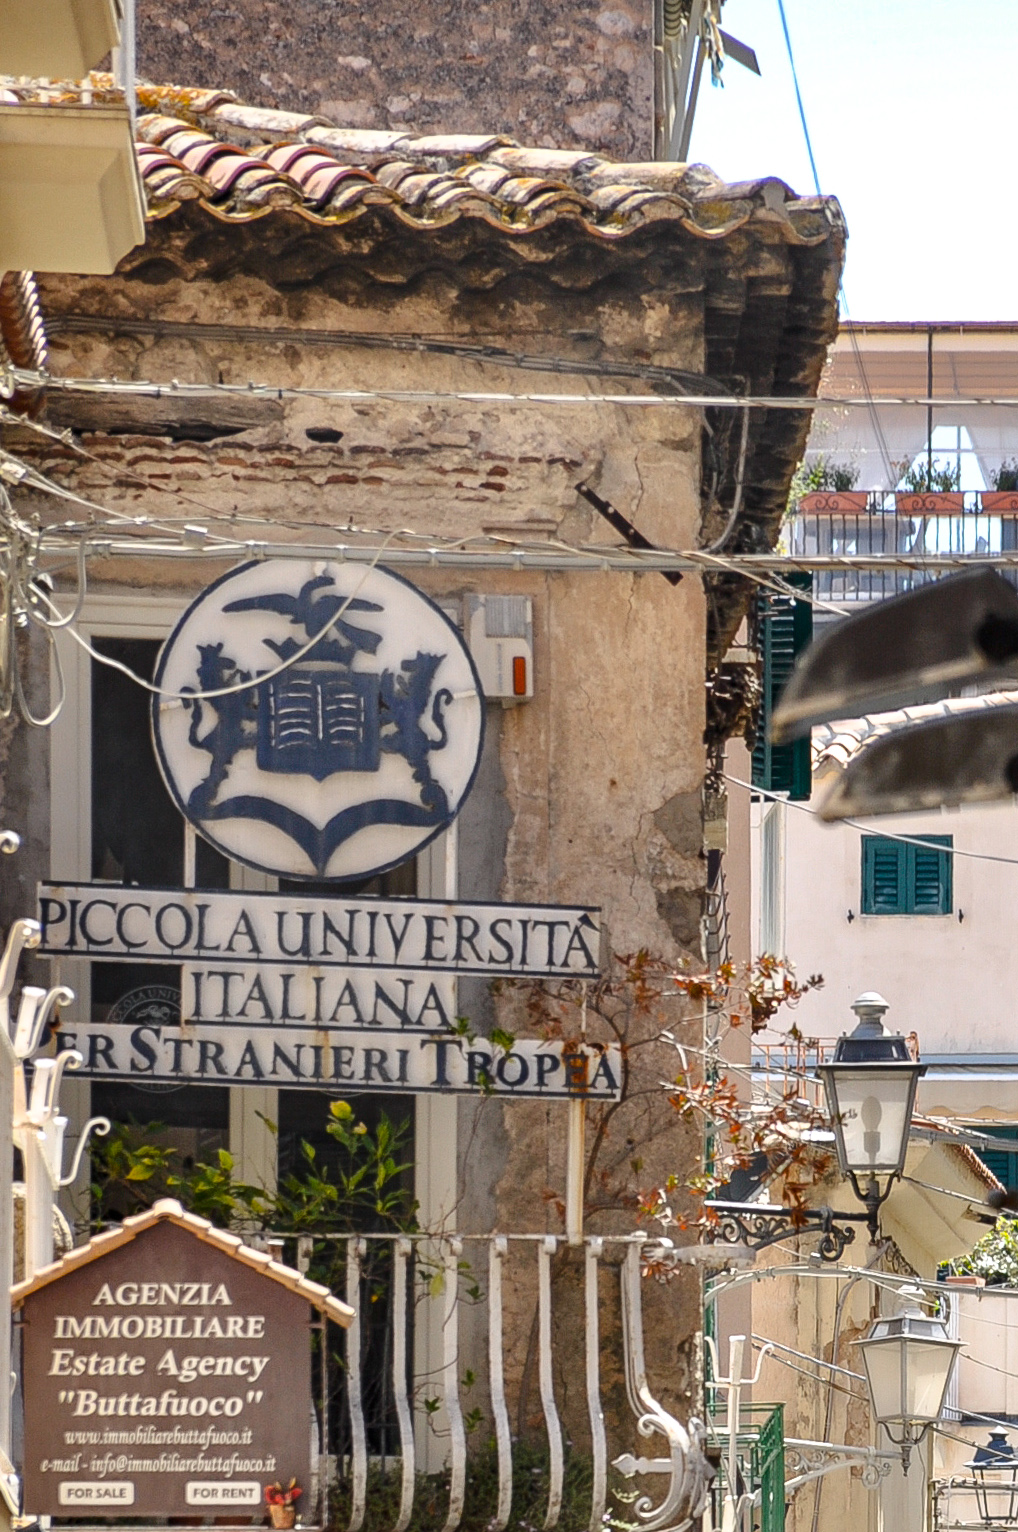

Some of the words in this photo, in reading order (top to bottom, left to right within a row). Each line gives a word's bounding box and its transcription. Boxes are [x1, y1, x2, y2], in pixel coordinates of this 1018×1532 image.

[39, 897, 262, 952] PICCOLA
[274, 910, 600, 969] UNIVERSITÀ
[191, 970, 450, 1027] ITALIANA
[130, 1026, 410, 1083] STRANIERI
[420, 1038, 620, 1090] TROPEA
[92, 1282, 233, 1306] AGENZIA
[53, 1315, 265, 1339] IMMOBILIARE
[48, 1348, 146, 1377] Estate
[156, 1348, 271, 1383] Agency
[57, 1389, 264, 1418] "Buttafuoco"
[64, 1425, 253, 1451] www.immobiliarebuttafuoco.it
[40, 1453, 80, 1473] e-mail
[90, 1452, 277, 1478] info@immobiliarebuttafuoco.it
[67, 1487, 93, 1499] FOR
[96, 1487, 127, 1499] SALE
[193, 1487, 219, 1499] FOR
[223, 1487, 255, 1499] RENT
